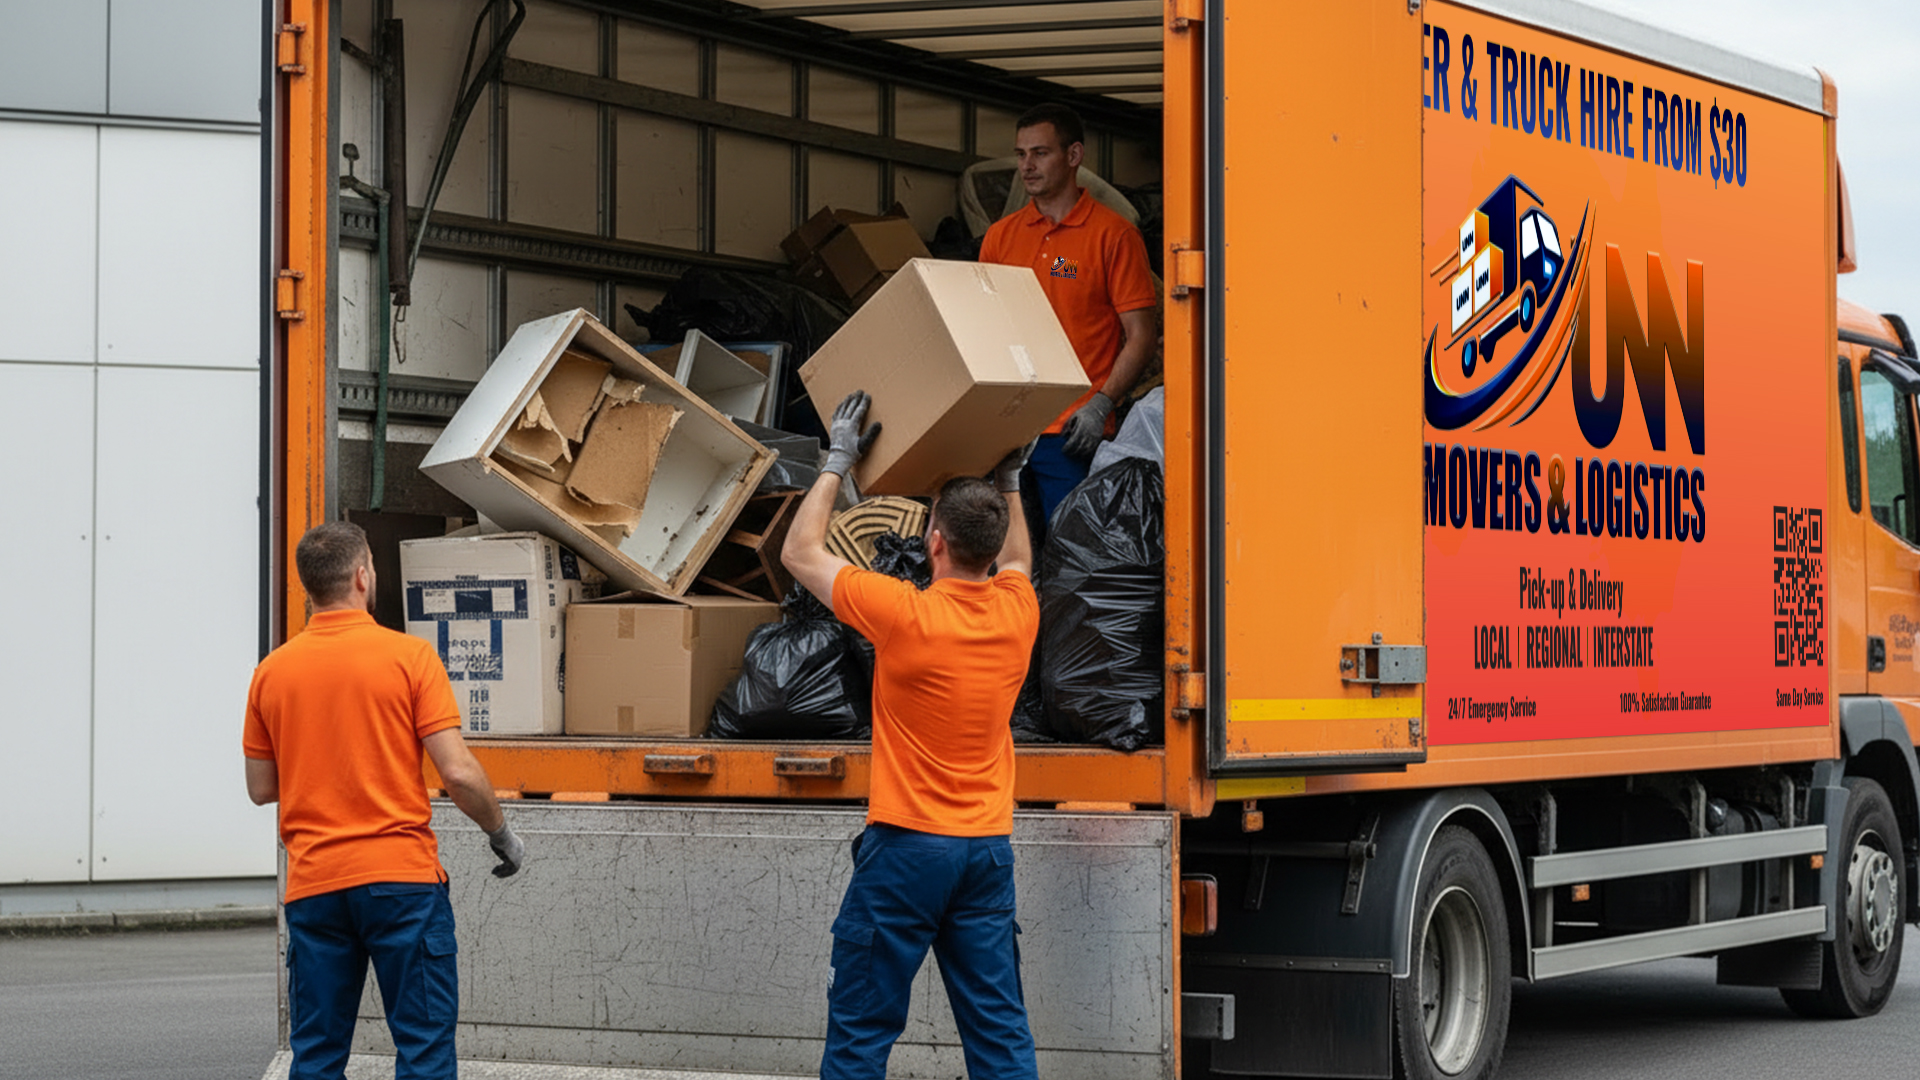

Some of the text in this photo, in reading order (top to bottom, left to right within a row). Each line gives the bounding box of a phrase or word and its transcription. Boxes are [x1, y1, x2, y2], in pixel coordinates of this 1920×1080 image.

[1461, 34, 1477, 121] &
[1487, 40, 1571, 143] TRUCK
[1580, 68, 1634, 159] HIRE
[1643, 86, 1701, 175] FROM
[1710, 97, 1746, 189] $30
[1424, 442, 1706, 543] MOVERS & LOGISTICS
[1520, 567, 1623, 619] Pick-up & Delivery
[1475, 625, 1653, 669] LOCAL REGIONAL INTERSTATE
[1449, 696, 1536, 723] 24/7 Emergency Service
[1620, 691, 1711, 713] 100% Satisfaction Guarantee
[1775, 688, 1823, 709] Same Day Service
